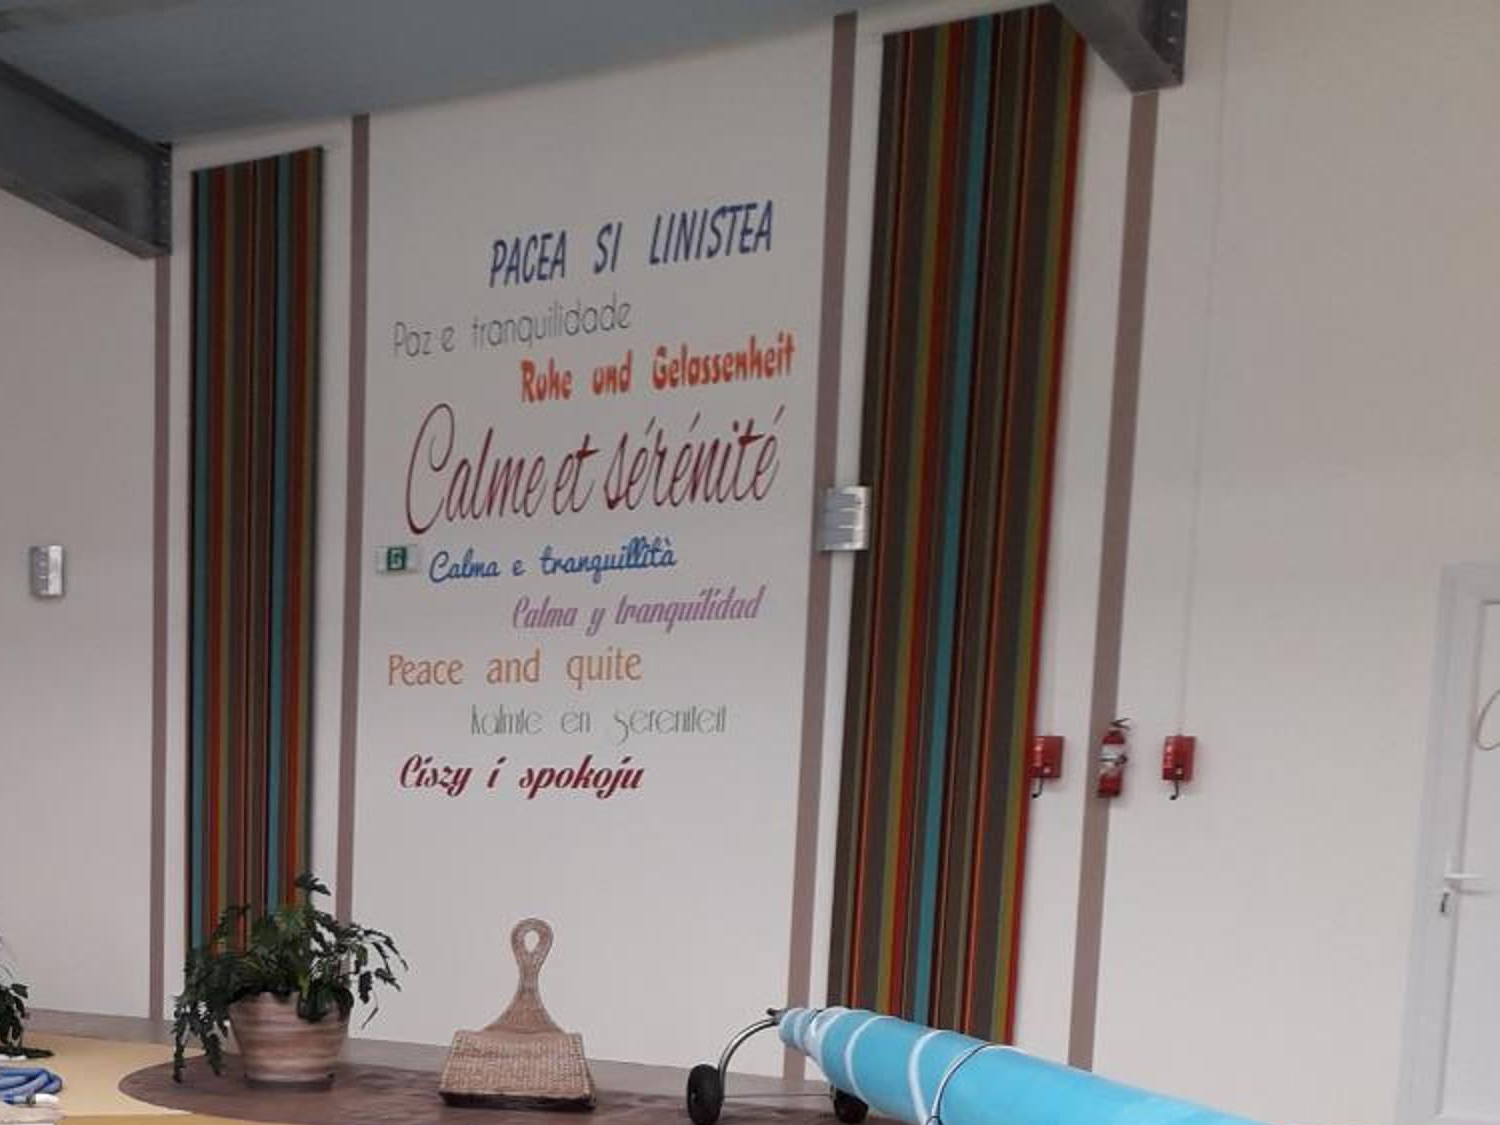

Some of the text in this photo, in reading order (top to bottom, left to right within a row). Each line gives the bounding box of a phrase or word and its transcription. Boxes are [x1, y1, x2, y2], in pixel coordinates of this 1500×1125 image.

[489, 200, 774, 288] PACEA SI LINISTEA
[394, 293, 632, 358] Paz e tranquilidade
[520, 331, 794, 402] Ruhe und Gelassenheit
[406, 403, 786, 535] Calme et sérénité
[429, 536, 677, 584] Calma e tranquillità
[513, 584, 767, 637] Calma y tranquilidad
[388, 647, 644, 690] Peace and quite
[400, 754, 645, 800] Ciszy i spokoju
